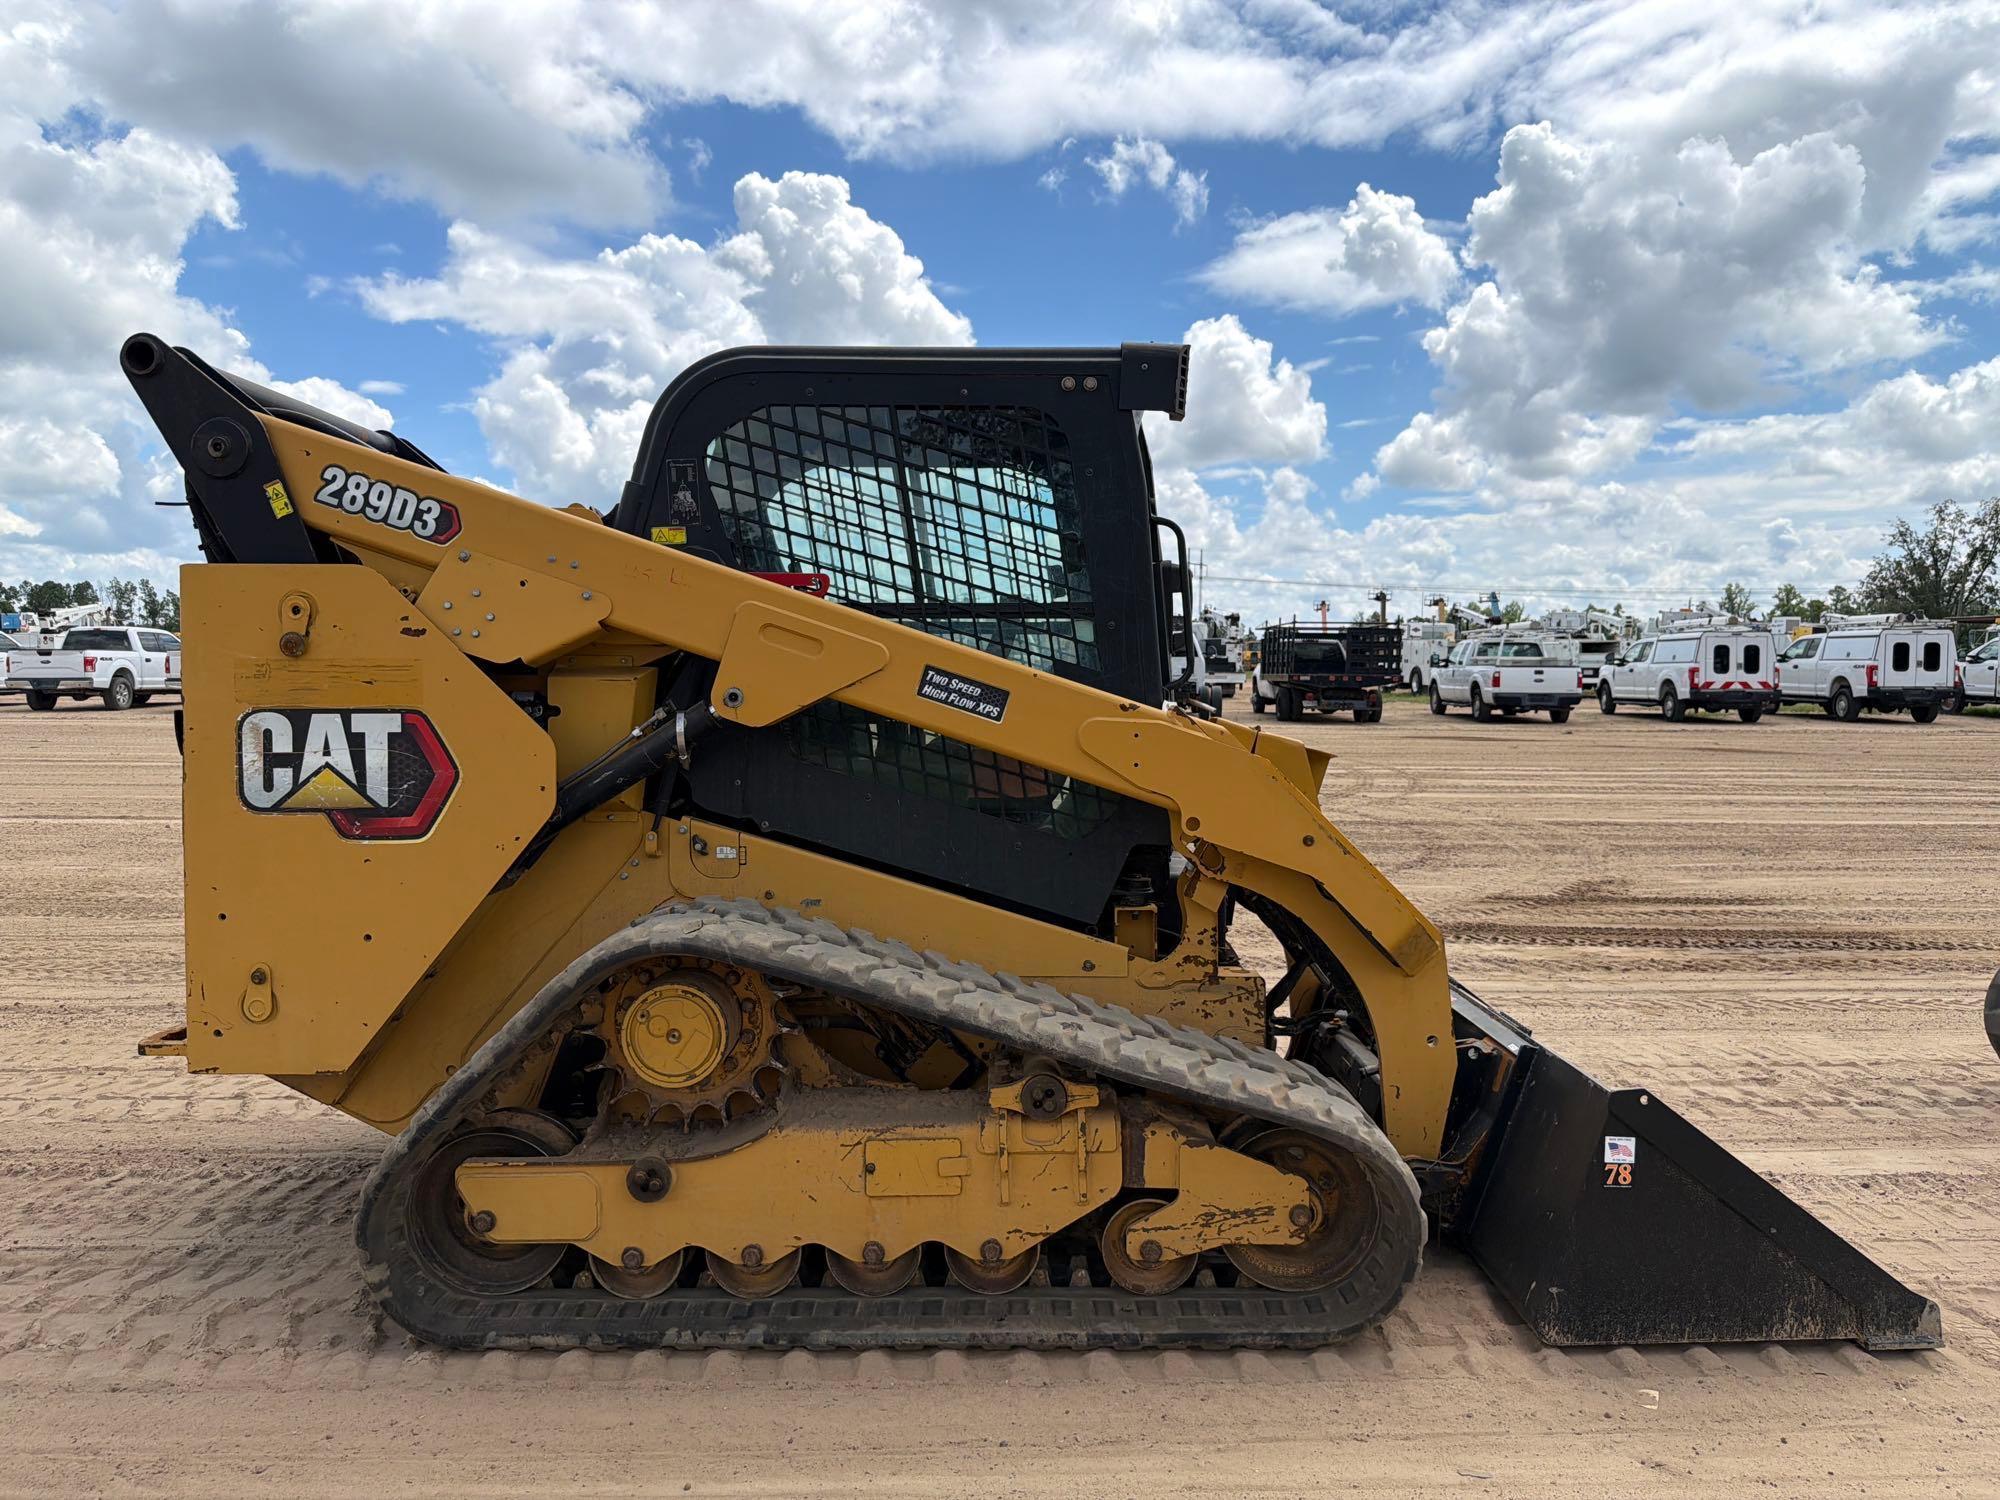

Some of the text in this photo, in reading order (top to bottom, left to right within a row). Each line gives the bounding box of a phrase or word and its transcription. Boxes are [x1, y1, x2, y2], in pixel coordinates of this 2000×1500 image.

[316, 466, 441, 537] 289D3
[977, 702, 1000, 717] XPS
[241, 711, 402, 808] CAT
[1604, 1163, 1632, 1185] 78
